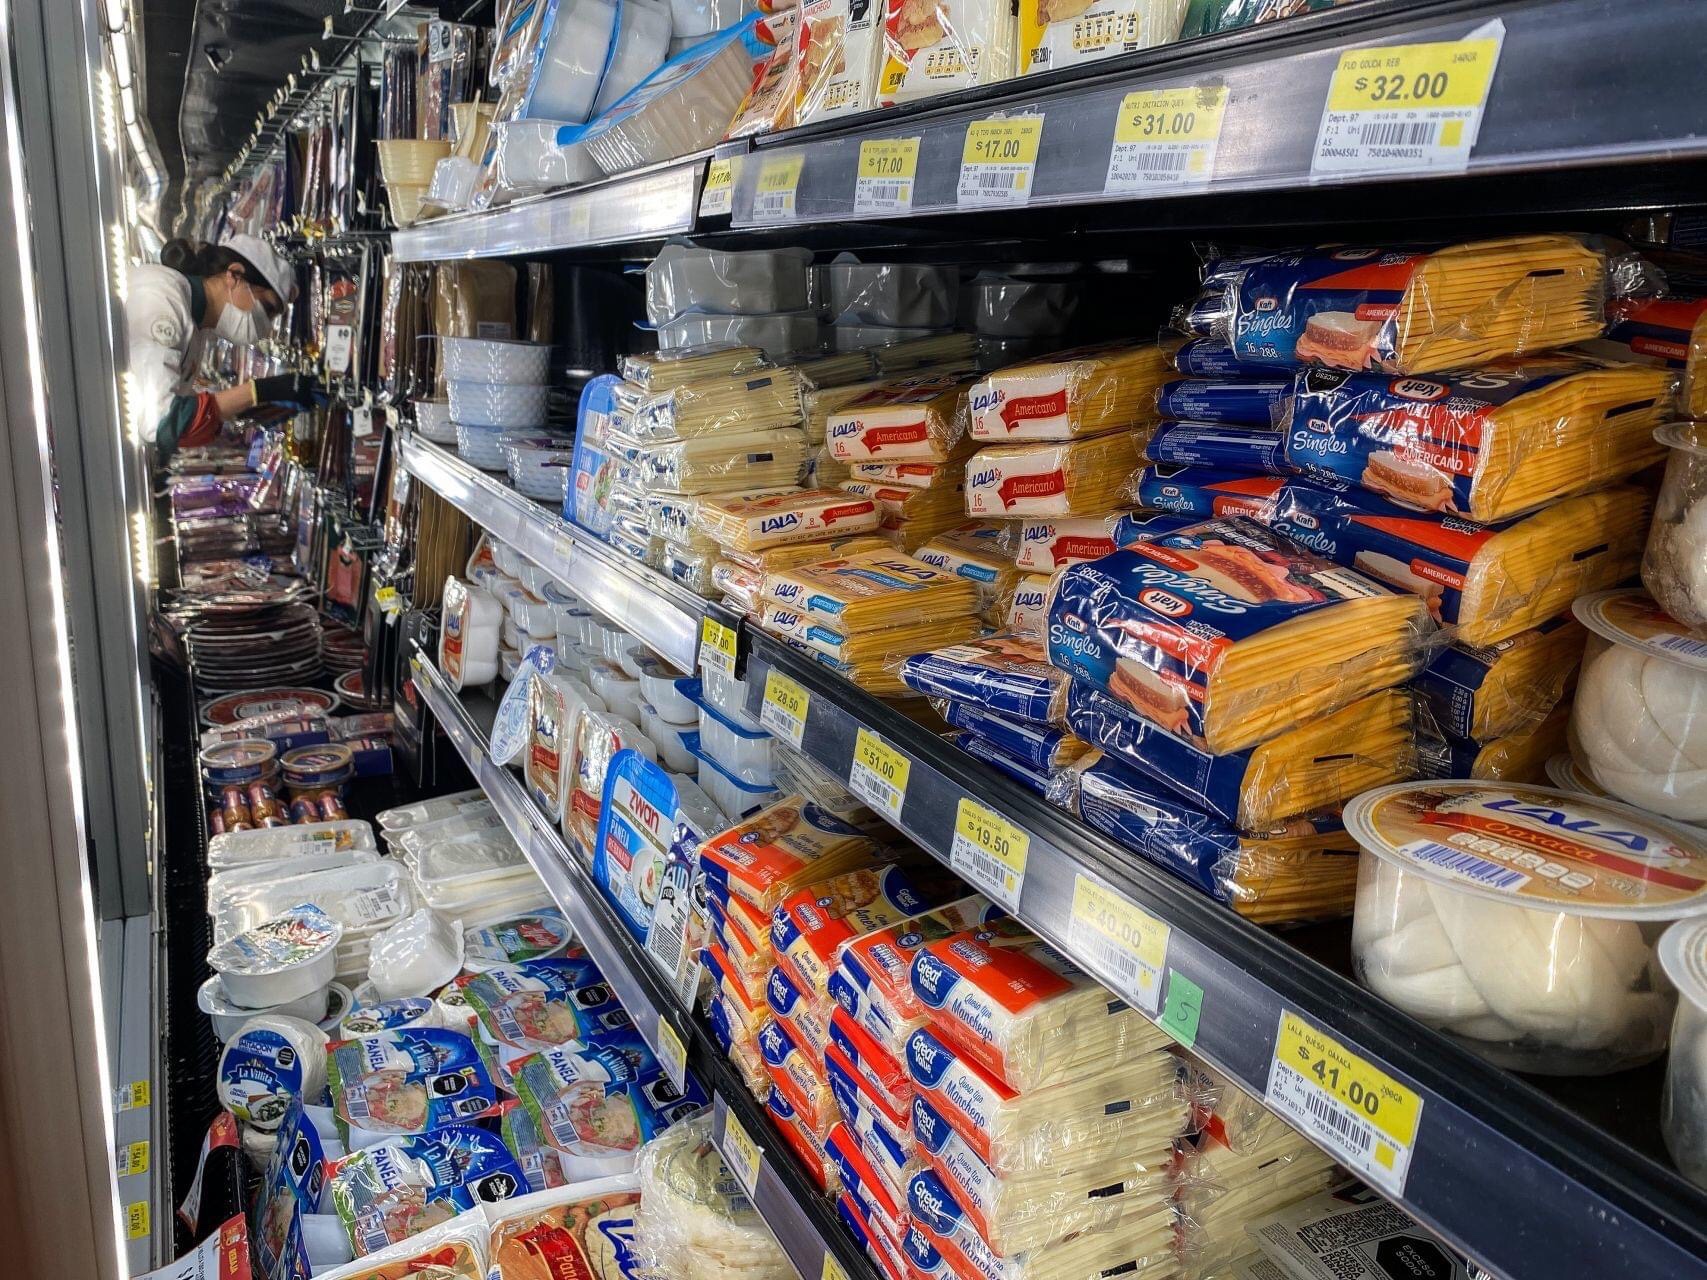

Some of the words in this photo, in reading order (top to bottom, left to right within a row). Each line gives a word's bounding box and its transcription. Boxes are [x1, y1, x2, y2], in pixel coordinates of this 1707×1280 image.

[1355, 71, 1448, 101] $32.00
[1132, 112, 1195, 136] $31.00
[975, 139, 1020, 158] $17.00
[868, 157, 902, 174] $17.00
[1258, 299, 1273, 310] Kraft
[1238, 309, 1292, 338] Singles
[1401, 379, 1441, 397] Kraft
[974, 391, 998, 411] LALA
[1015, 401, 1057, 417] Americano
[833, 421, 857, 438] LALA
[974, 416, 984, 430] 16
[1310, 420, 1326, 432] Kraft
[876, 430, 918, 442] Americano
[1293, 431, 1347, 456] Singles
[835, 442, 845, 453] 16
[973, 468, 996, 488] LALA
[1012, 480, 1055, 495] Americano
[973, 494, 983, 507] 16
[1152, 494, 1195, 512] Singles
[832, 504, 868, 519] Americano
[1296, 514, 1314, 528] Kraft
[761, 513, 799, 534] LALA
[1024, 525, 1048, 541] LALA
[1065, 541, 1110, 556] Americano
[1273, 522, 1337, 555] Singles
[1022, 546, 1032, 561] 16
[1422, 567, 1461, 587] AMERICANO
[774, 583, 798, 598] LALA
[1015, 592, 1044, 606] LALA
[1131, 563, 1250, 614] Singles
[1151, 592, 1184, 612] Kraft
[773, 610, 798, 626] LALA
[1014, 611, 1024, 625] 16
[1066, 614, 1083, 632] Kraft
[1049, 624, 1102, 660] Singles
[1059, 652, 1071, 667] 16
[772, 687, 799, 712] $28.50
[863, 747, 894, 780] $51.00
[629, 789, 660, 834] zwan
[967, 821, 1010, 857] $19.50
[1485, 819, 1599, 862] Oaxaca
[1086, 900, 1142, 949] $40.00
[917, 956, 942, 984] Great
[918, 975, 938, 994] Value
[964, 993, 983, 1012] Queso
[978, 1004, 993, 1022] tipo
[951, 998, 993, 1045] Manchego
[912, 1034, 937, 1062] Great
[1305, 1034, 1325, 1053] QUESO
[1328, 1046, 1351, 1071] OAXACA
[549, 1051, 580, 1086] PANELA
[915, 1054, 932, 1074] Value
[239, 1067, 249, 1078] La
[250, 1068, 273, 1085] Villita
[1296, 1045, 1380, 1116] $41.00
[958, 1075, 975, 1095] Queso
[972, 1089, 984, 1104] tipo
[915, 1099, 936, 1127] Great
[944, 1079, 986, 1130] Manchego
[371, 1147, 400, 1192] PANELA
[956, 1152, 972, 1174] Queso
[945, 1155, 983, 1208] Manchego
[914, 1180, 943, 1212] Great
[1333, 1250, 1361, 1278] GOUDA
[1340, 1247, 1366, 1275] QUESO
[1395, 1250, 1422, 1277] SODIO
[1402, 1244, 1436, 1278] EXCESO
